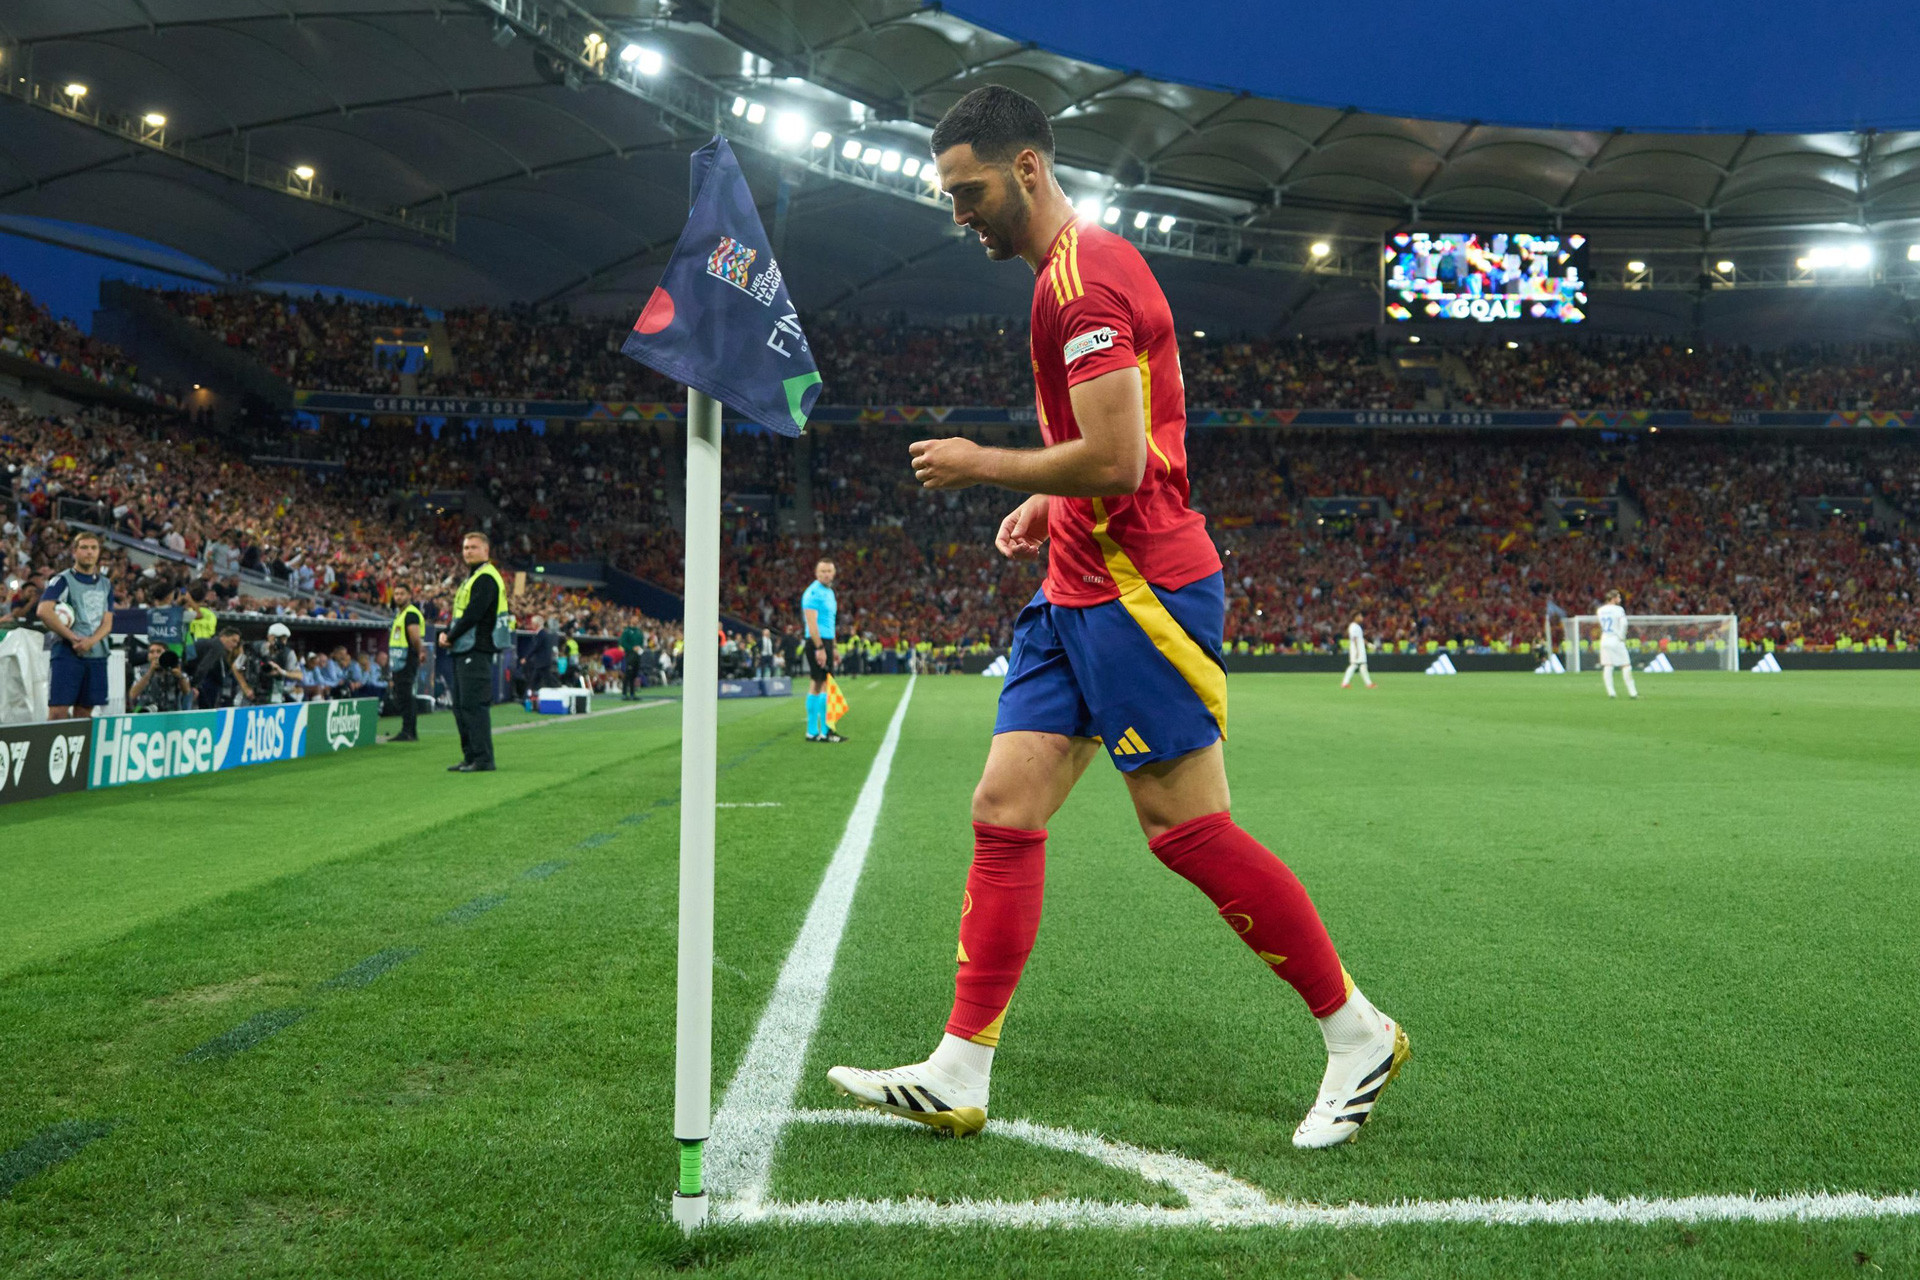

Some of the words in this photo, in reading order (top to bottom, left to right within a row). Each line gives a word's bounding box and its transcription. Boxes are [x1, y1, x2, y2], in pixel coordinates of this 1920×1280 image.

[750, 273, 764, 292] UEFA
[754, 258, 777, 302] NATIONS
[1093, 332, 1109, 344] 10
[374, 398, 469, 412] GERMANY
[481, 401, 526, 414] 2025
[1355, 413, 1441, 424] GERMANY
[1450, 413, 1493, 424] 2025
[241, 708, 285, 763] Atos
[93, 718, 213, 786] Hisense
